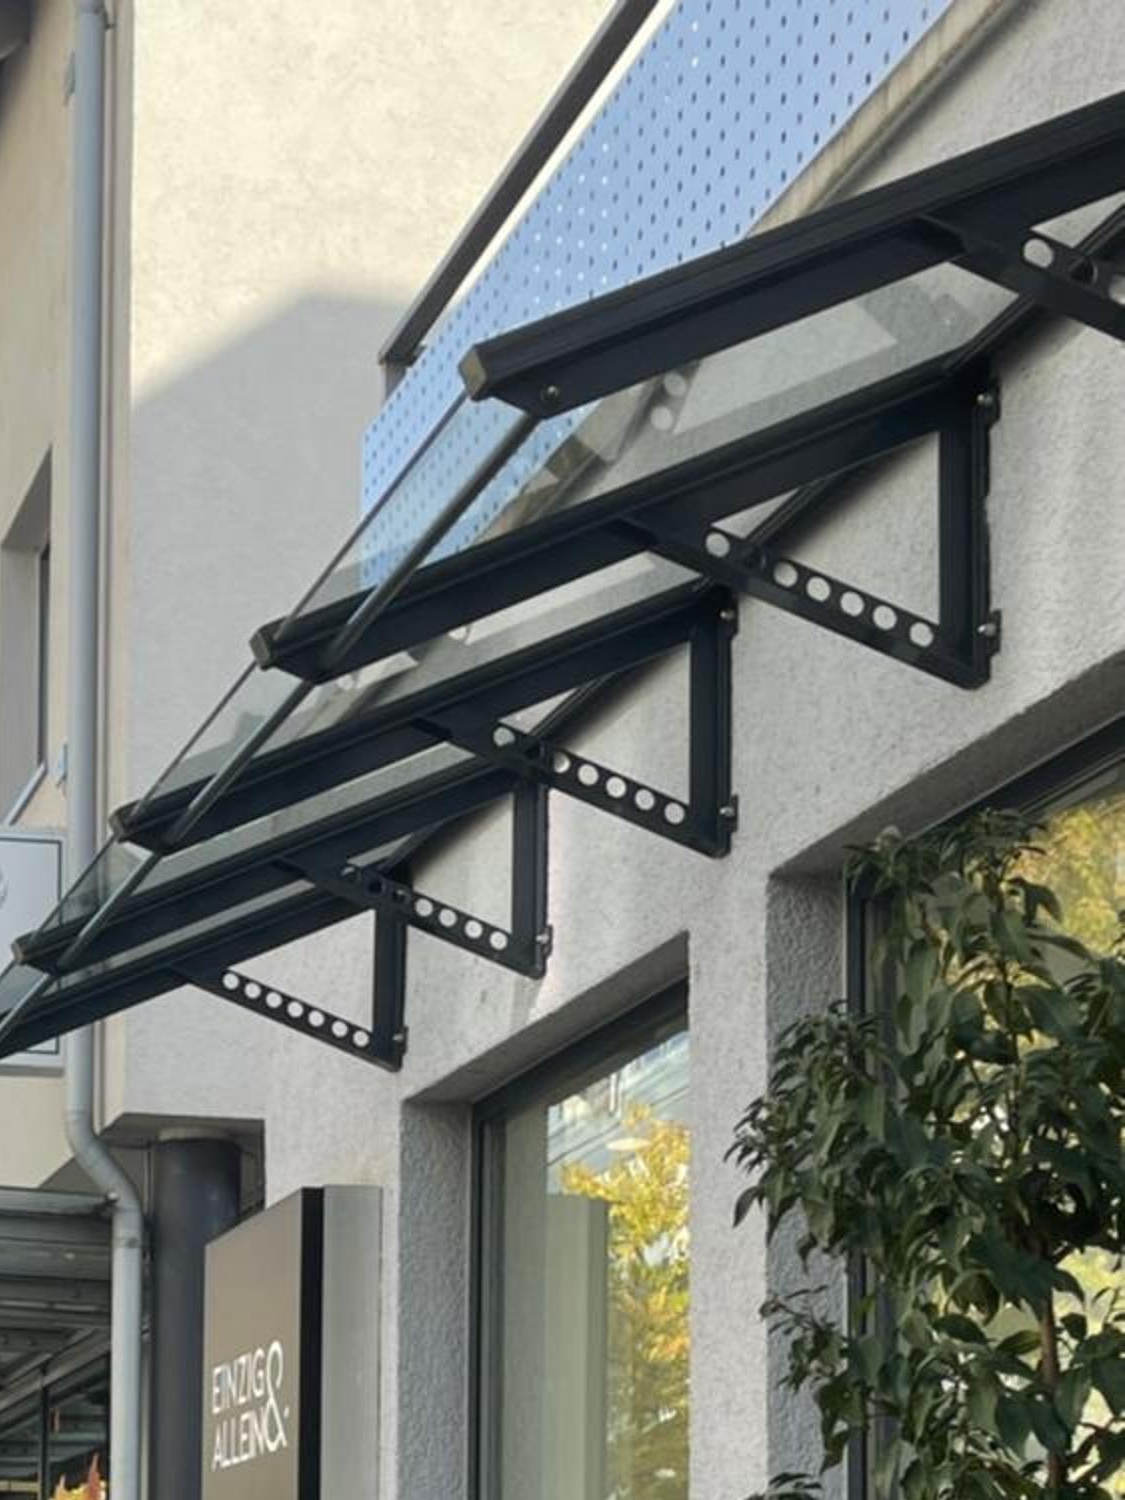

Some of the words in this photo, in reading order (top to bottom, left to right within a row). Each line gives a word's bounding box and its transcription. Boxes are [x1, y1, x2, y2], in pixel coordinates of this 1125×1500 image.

[212, 1347, 266, 1415] EINZIG
[266, 1340, 290, 1453] &
[212, 1406, 268, 1472] ALLEIN
